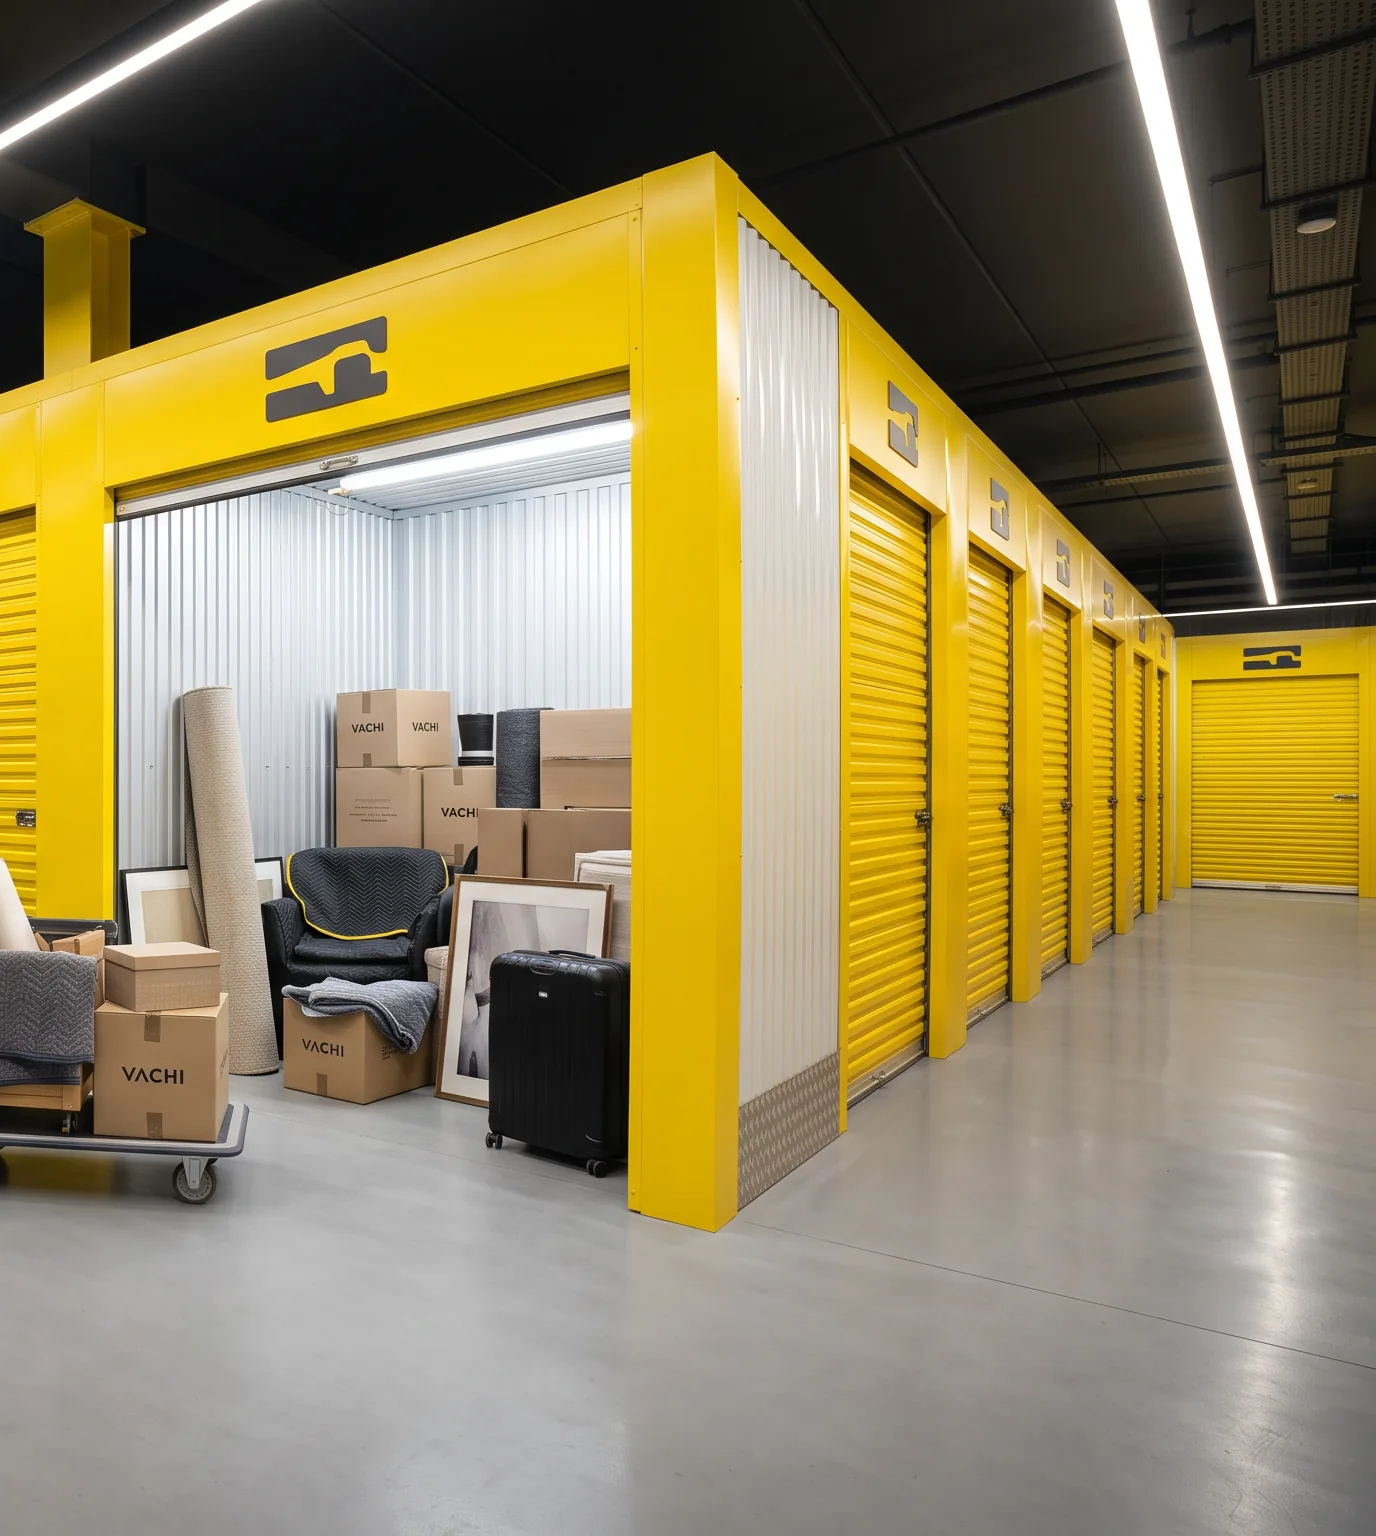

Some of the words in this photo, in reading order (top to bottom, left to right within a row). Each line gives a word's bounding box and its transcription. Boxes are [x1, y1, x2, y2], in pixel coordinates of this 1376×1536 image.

[351, 722, 384, 733] VACHI
[411, 722, 439, 732] VACHI
[301, 1038, 344, 1058] VACHI
[121, 1066, 184, 1085] VACHI
